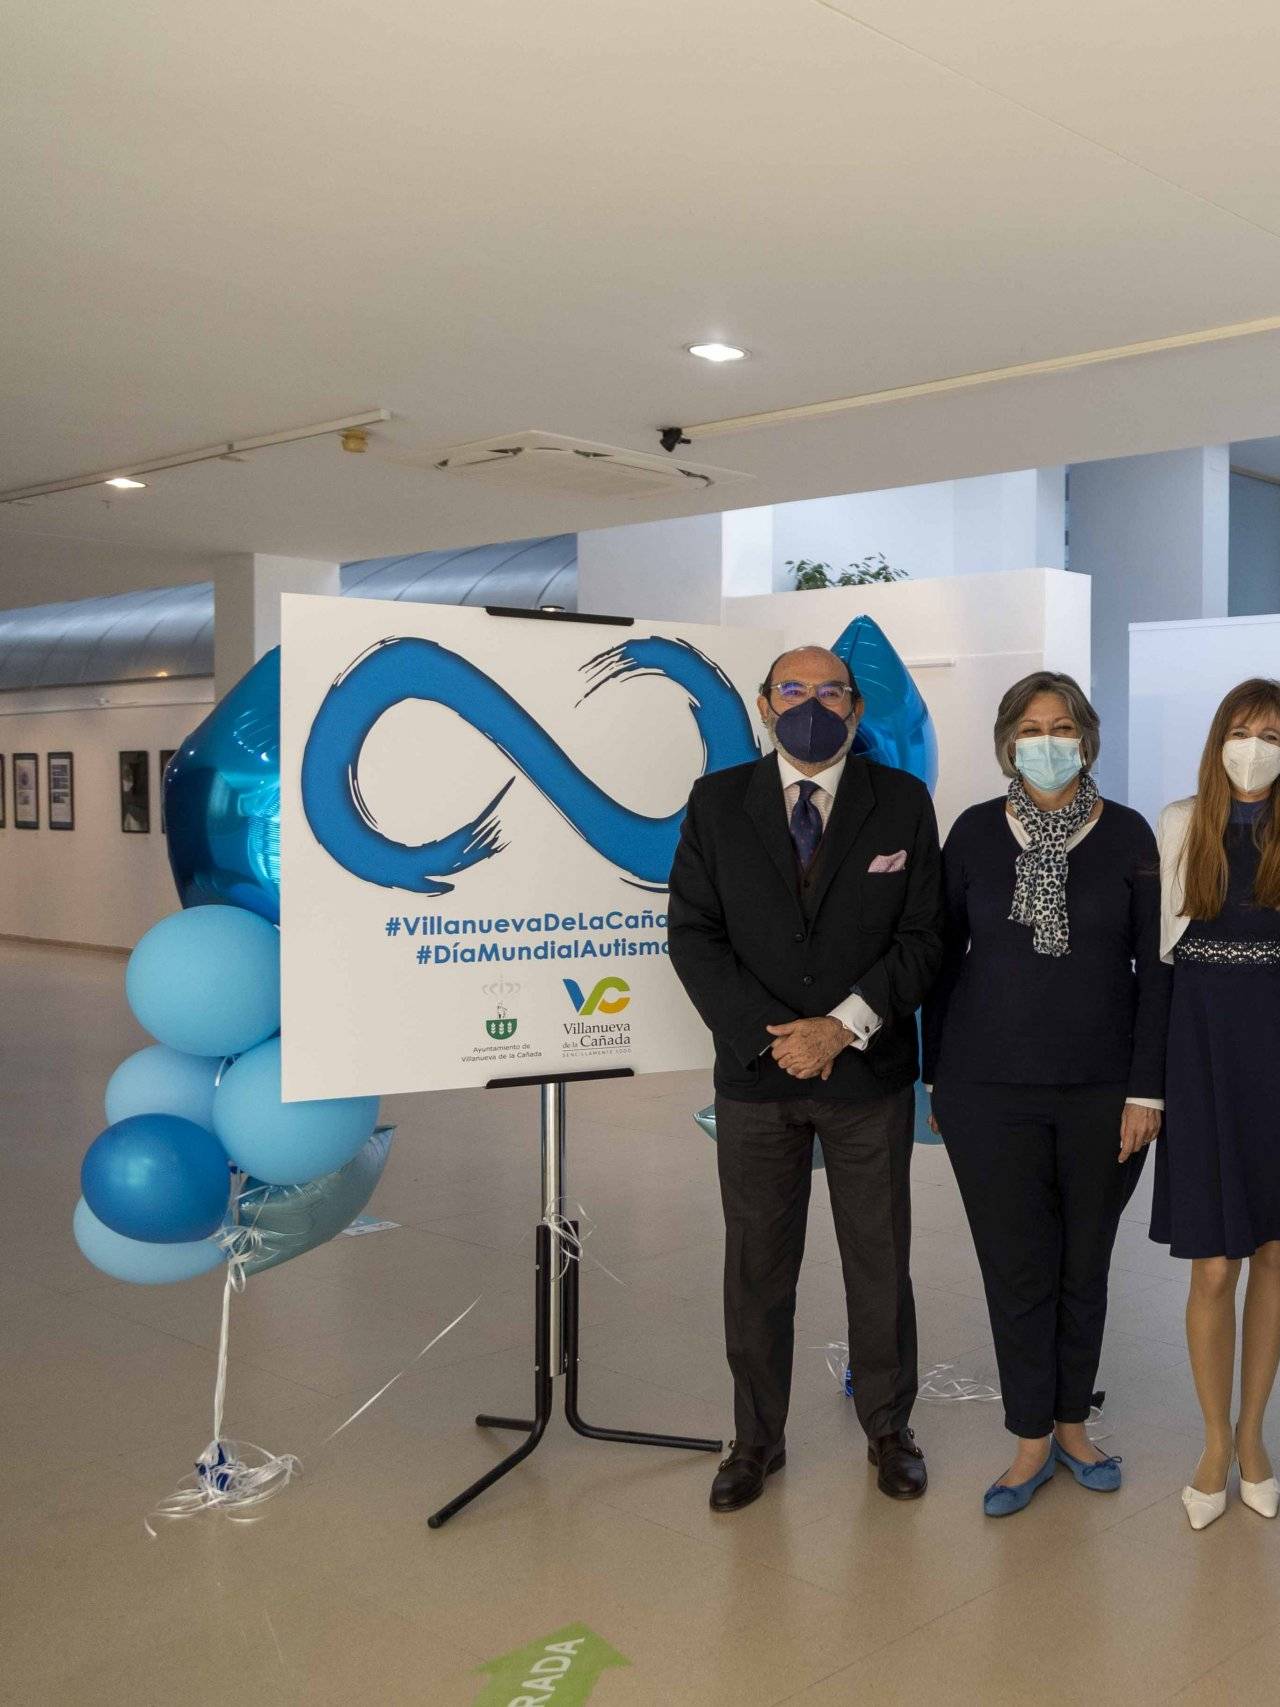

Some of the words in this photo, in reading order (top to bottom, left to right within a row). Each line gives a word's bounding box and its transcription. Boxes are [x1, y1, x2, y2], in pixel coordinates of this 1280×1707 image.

[385, 909, 669, 936] #VillanuevaDeLaCaña
[563, 1022, 631, 1035] Villanueva
[580, 1033, 631, 1047] Cañada
[473, 1043, 521, 1055] Ayuntamiento
[516, 1050, 543, 1059] Cañada
[507, 1637, 586, 1707] RADA
